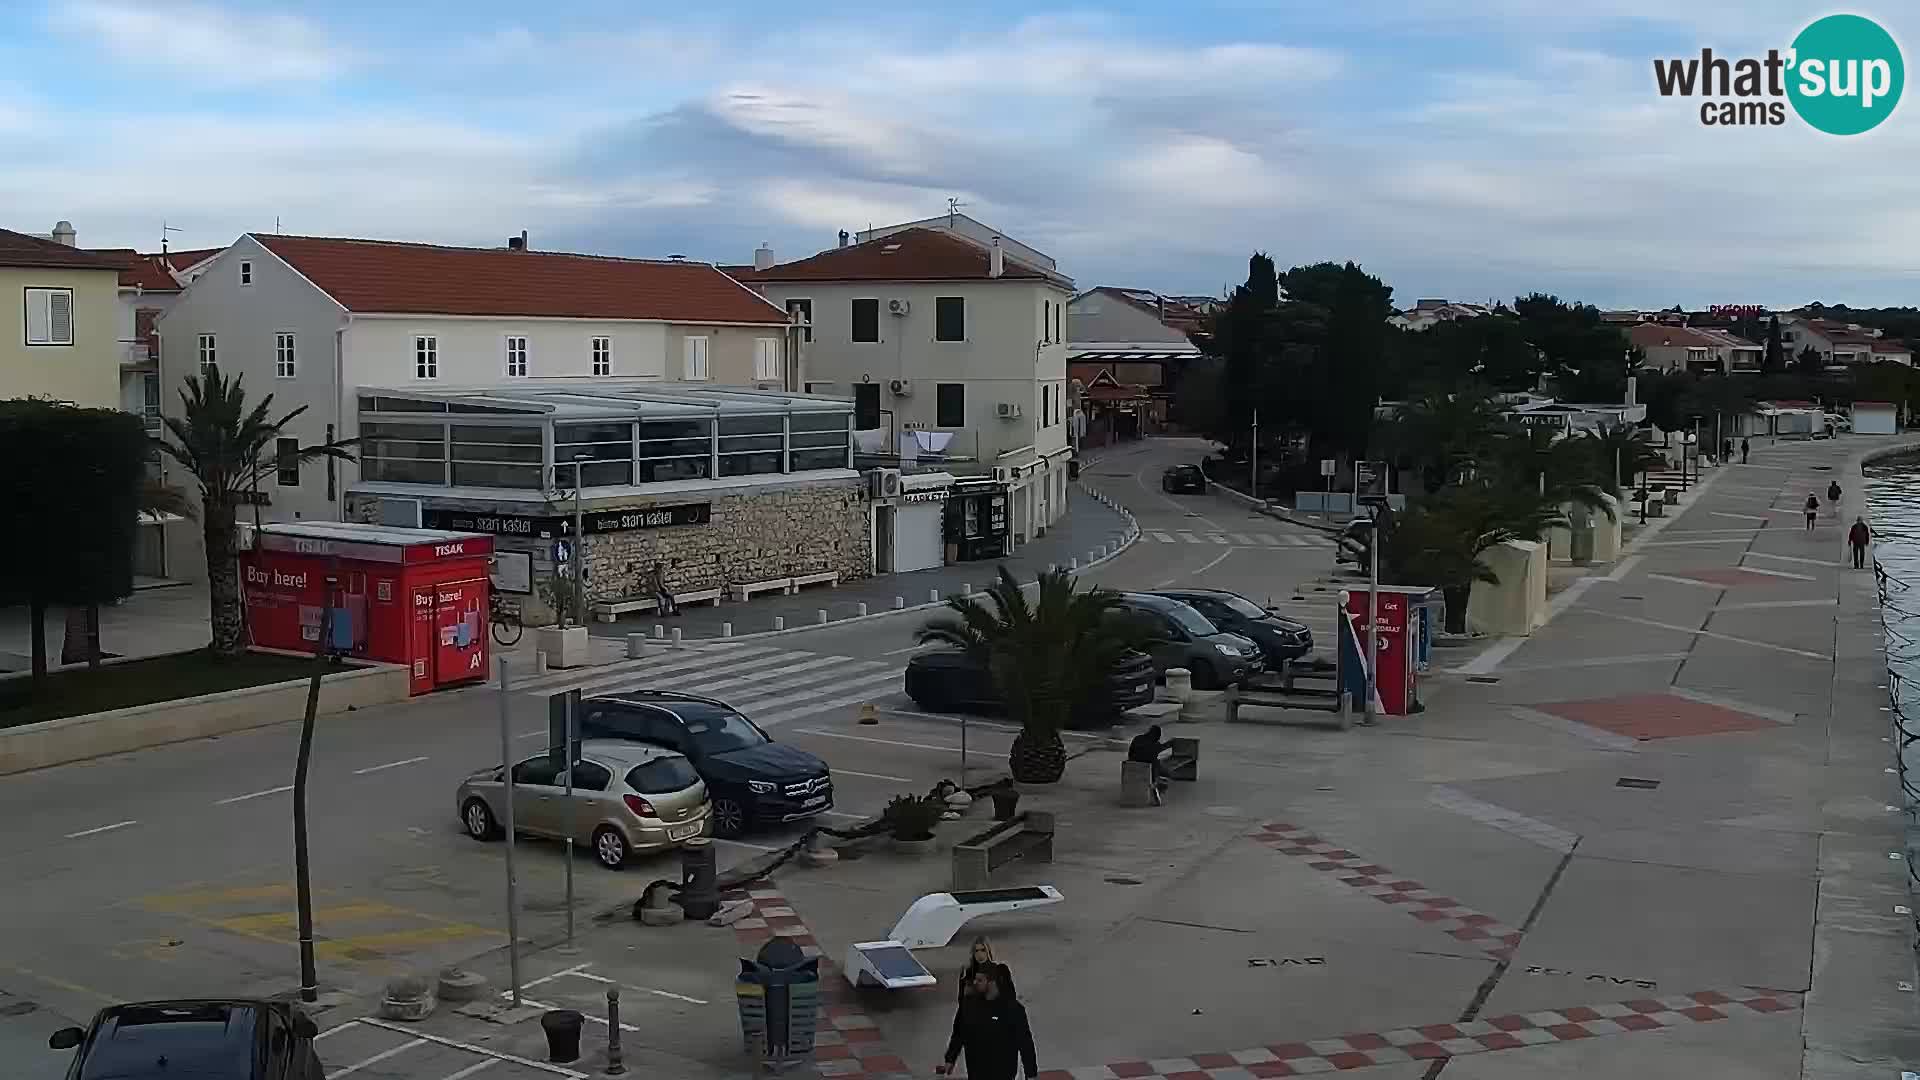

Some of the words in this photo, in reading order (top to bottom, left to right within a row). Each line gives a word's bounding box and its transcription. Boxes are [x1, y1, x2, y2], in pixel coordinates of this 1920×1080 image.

[434, 544, 464, 556] TISAK
[247, 565, 269, 584] Buy
[274, 568, 307, 588] here!
[415, 594, 433, 607] Buy
[439, 589, 462, 603] here!
